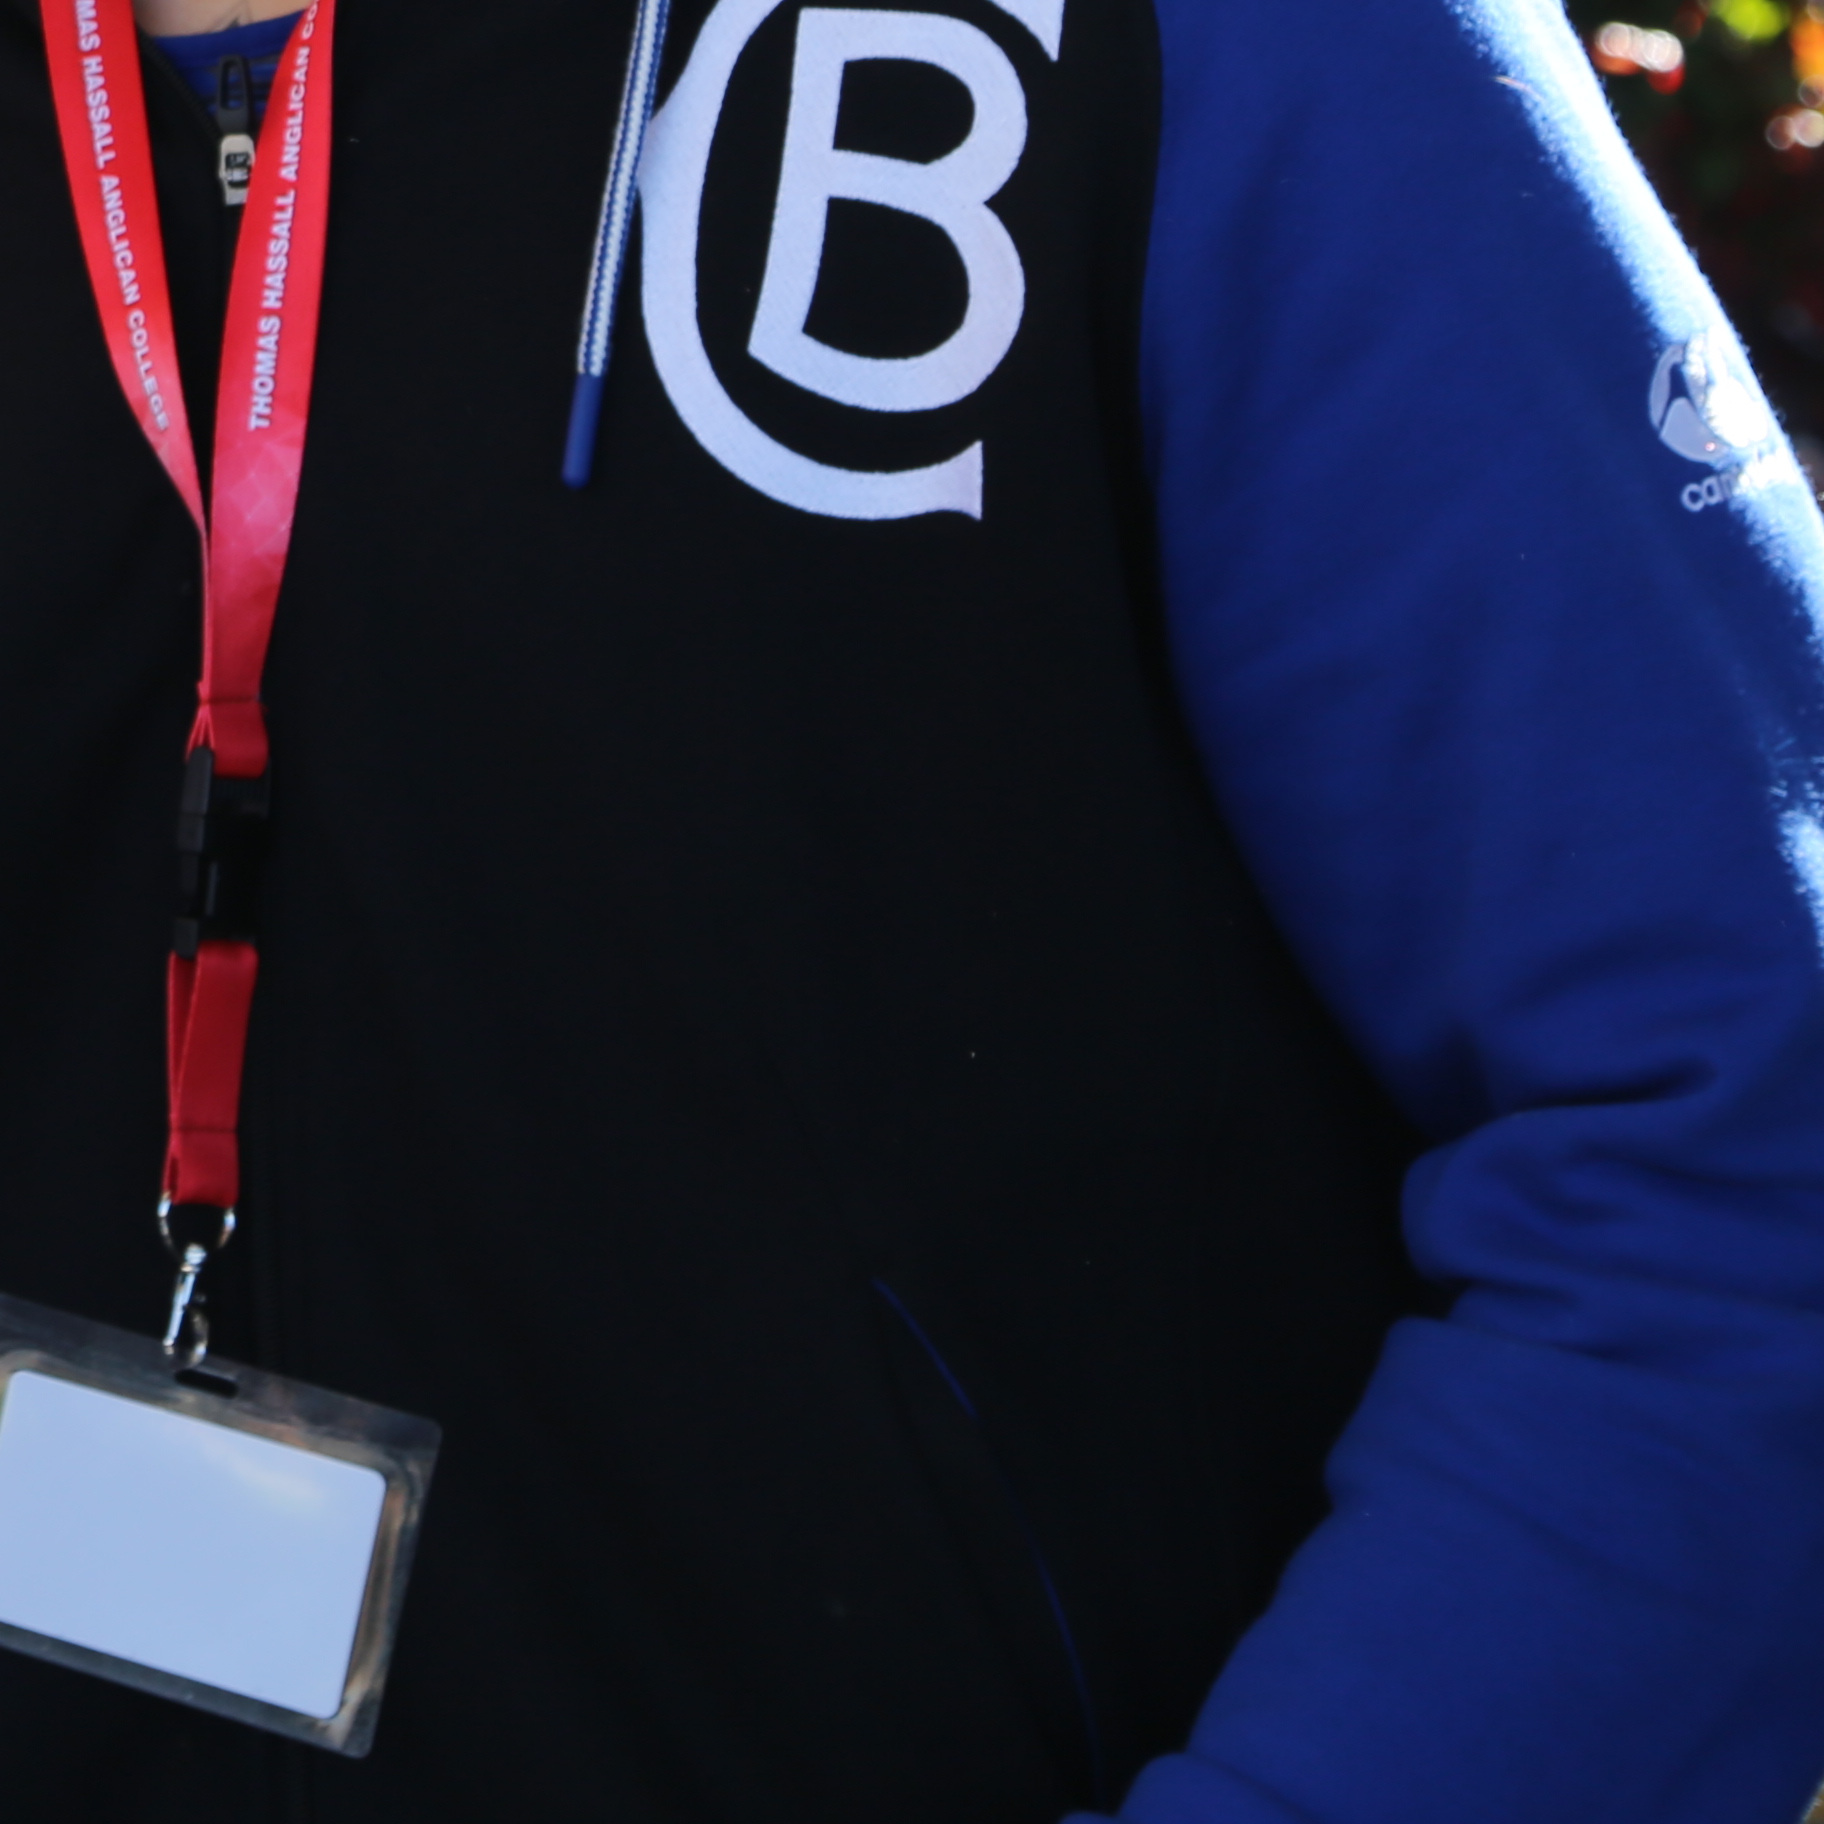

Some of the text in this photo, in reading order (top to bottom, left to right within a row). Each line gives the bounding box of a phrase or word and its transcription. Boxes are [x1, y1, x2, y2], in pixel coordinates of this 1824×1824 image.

[82, 56, 116, 169] HASSALL
[100, 174, 141, 306] ANGLICAN
[126, 309, 170, 430] COLLEGE
[248, 45, 311, 431] THOMAS HASSALL ANGLICAN
